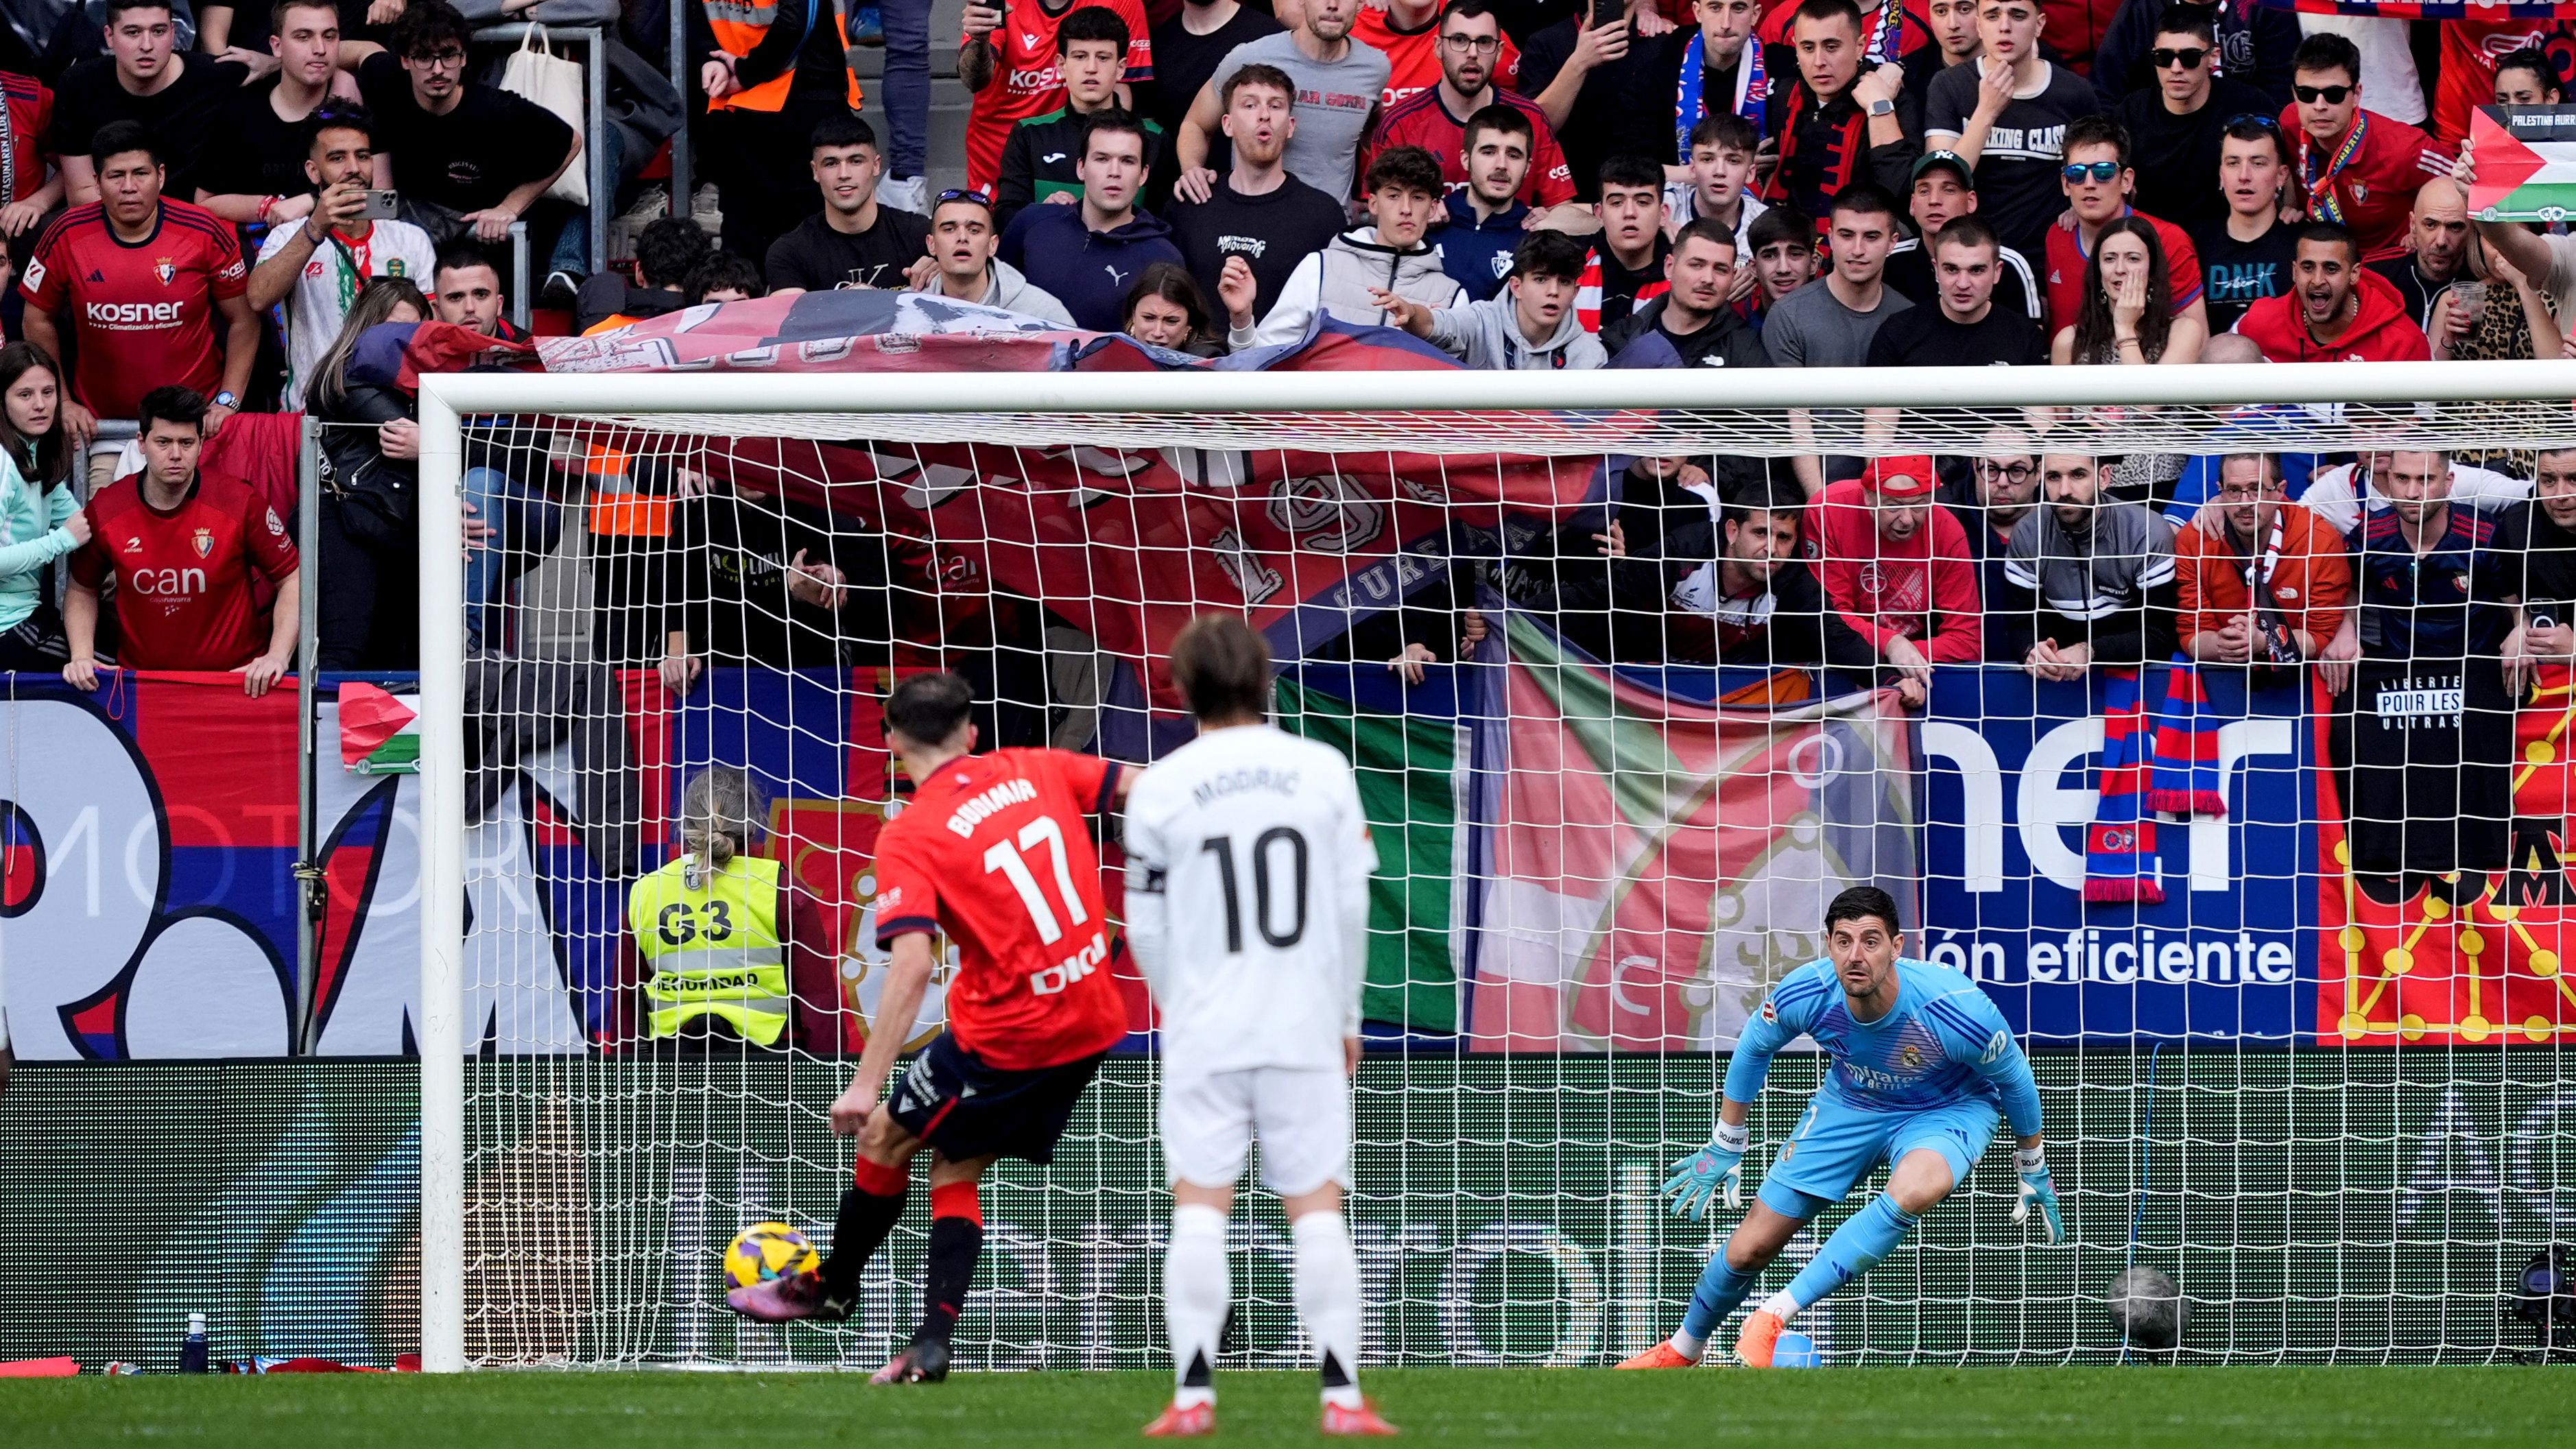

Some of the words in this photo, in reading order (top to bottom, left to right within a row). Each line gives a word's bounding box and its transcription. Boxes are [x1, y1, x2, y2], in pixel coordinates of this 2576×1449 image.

[2512, 115, 2553, 126] PALESTINA
[2209, 263, 2277, 300] DNK
[132, 568, 206, 595] can
[2380, 675, 2461, 691] LIBERTE
[2383, 694, 2424, 713] POUR
[2432, 693, 2460, 711] LES
[2383, 715, 2459, 730] ULTRAS
[946, 778, 1038, 839] BUDIMIR
[983, 814, 1089, 947] 17
[1202, 827, 1308, 953] 10
[658, 900, 732, 946] G3
[2027, 930, 2293, 982] eficiente
